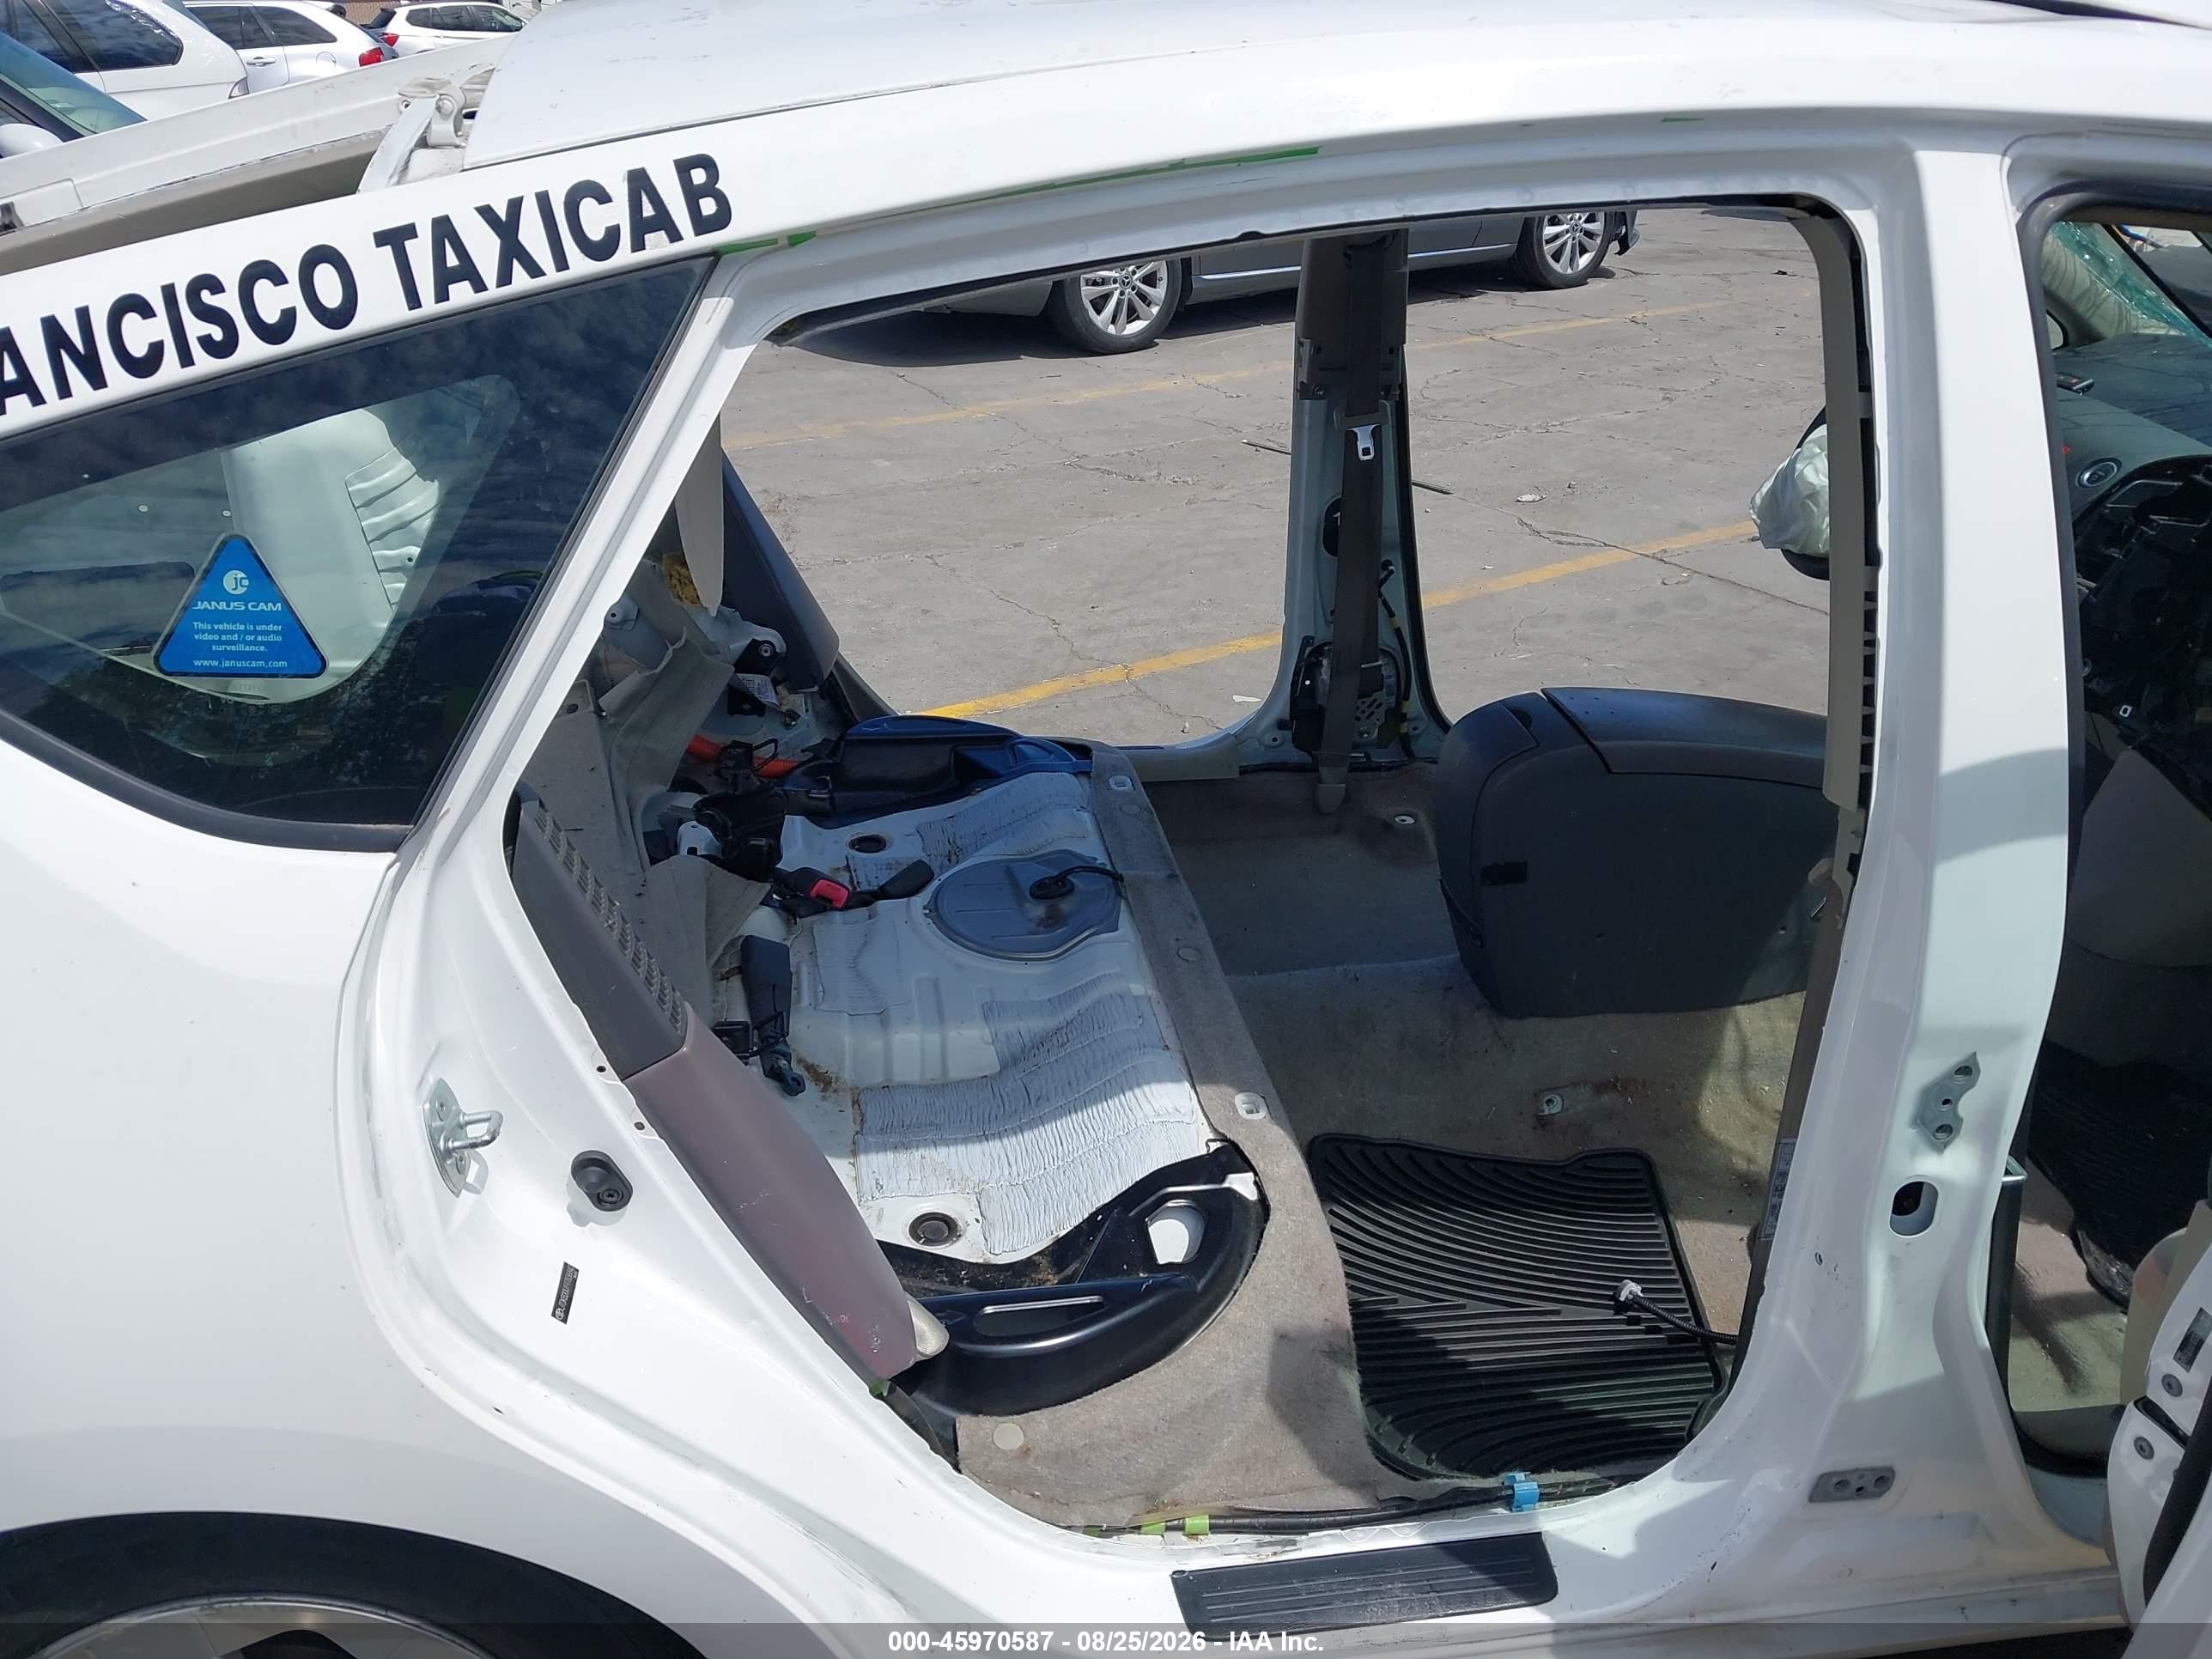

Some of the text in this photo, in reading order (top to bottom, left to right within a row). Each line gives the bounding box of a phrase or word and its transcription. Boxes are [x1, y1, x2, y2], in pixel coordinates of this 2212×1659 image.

[373, 153, 732, 311] TAXICAB
[192, 600, 282, 611] JANUS CAM
[192, 622, 283, 631] This vehicle is under
[194, 632, 219, 641] video
[221, 633, 238, 641] and
[211, 643, 268, 652] surveillance.
[193, 658, 288, 668] www.januscam.com
